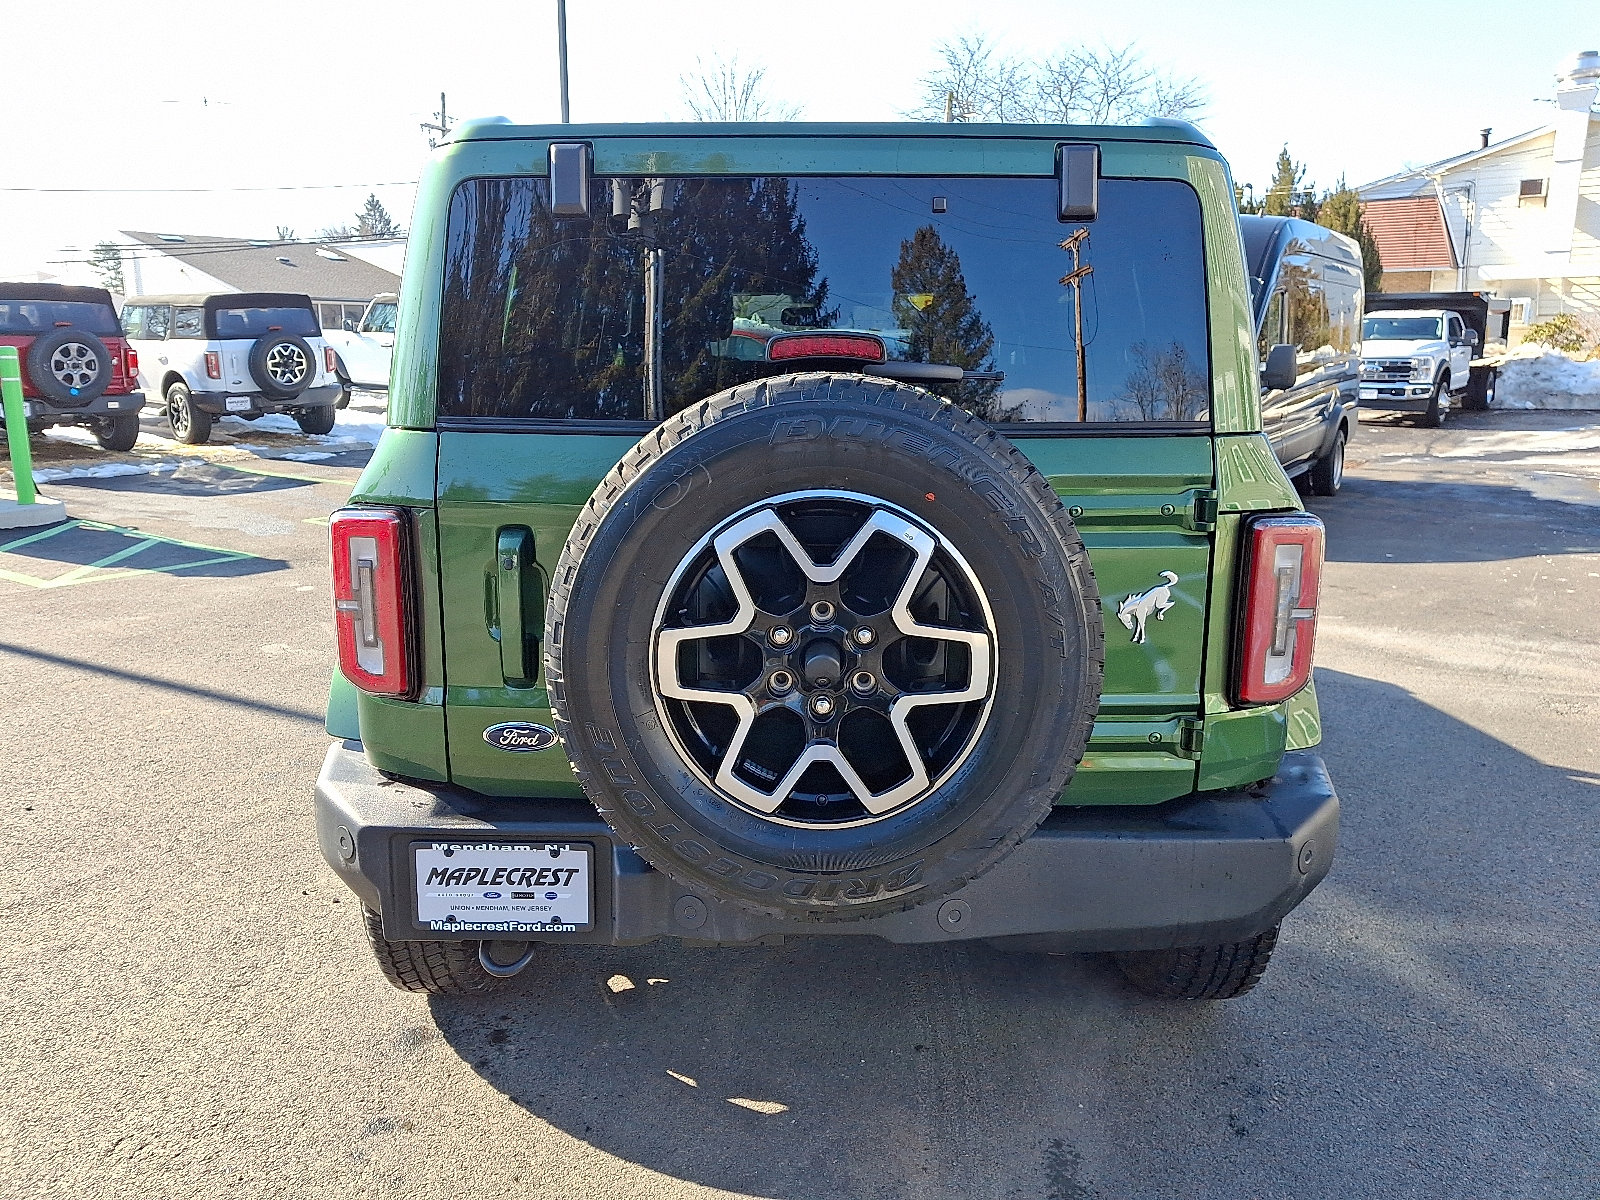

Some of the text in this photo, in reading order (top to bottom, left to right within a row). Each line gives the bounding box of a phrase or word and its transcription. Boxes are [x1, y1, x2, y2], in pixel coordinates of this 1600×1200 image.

[499, 728, 540, 746] Ford
[425, 867, 580, 888] MAPLECREST
[430, 920, 576, 933] MaplecrestFord.com
